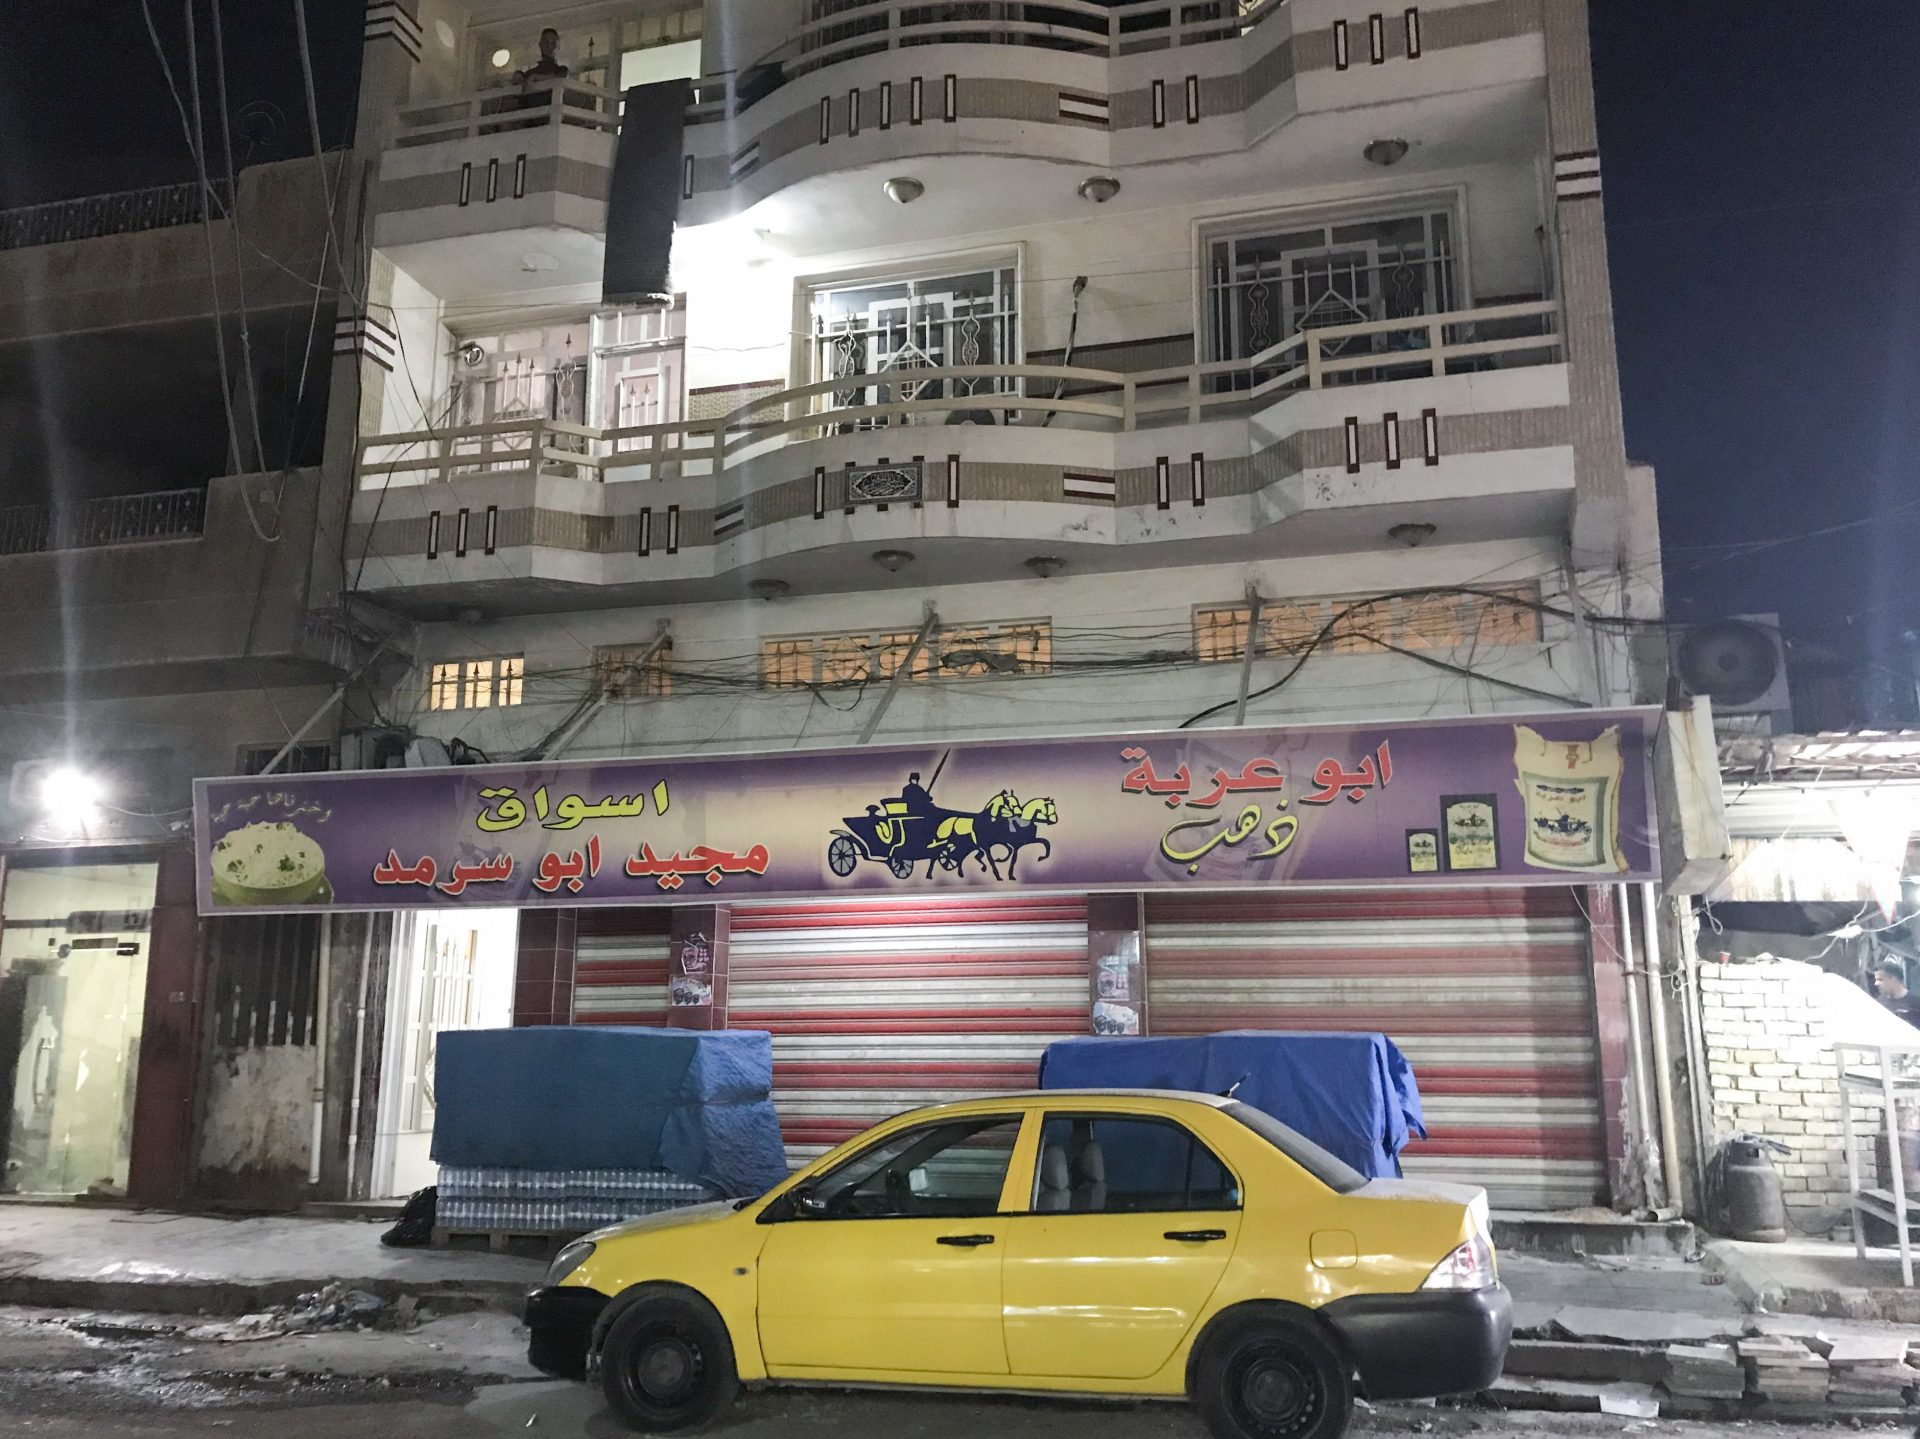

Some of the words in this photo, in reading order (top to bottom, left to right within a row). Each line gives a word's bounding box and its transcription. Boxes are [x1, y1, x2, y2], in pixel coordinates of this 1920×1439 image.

[1120, 746, 1287, 807] عربة
[1299, 738, 1393, 803] ابو
[476, 779, 670, 833] اسواق
[532, 834, 602, 894] ابو
[626, 841, 771, 891] مجيد
[1160, 798, 1299, 876] ذهب
[373, 848, 514, 896] سرمد
